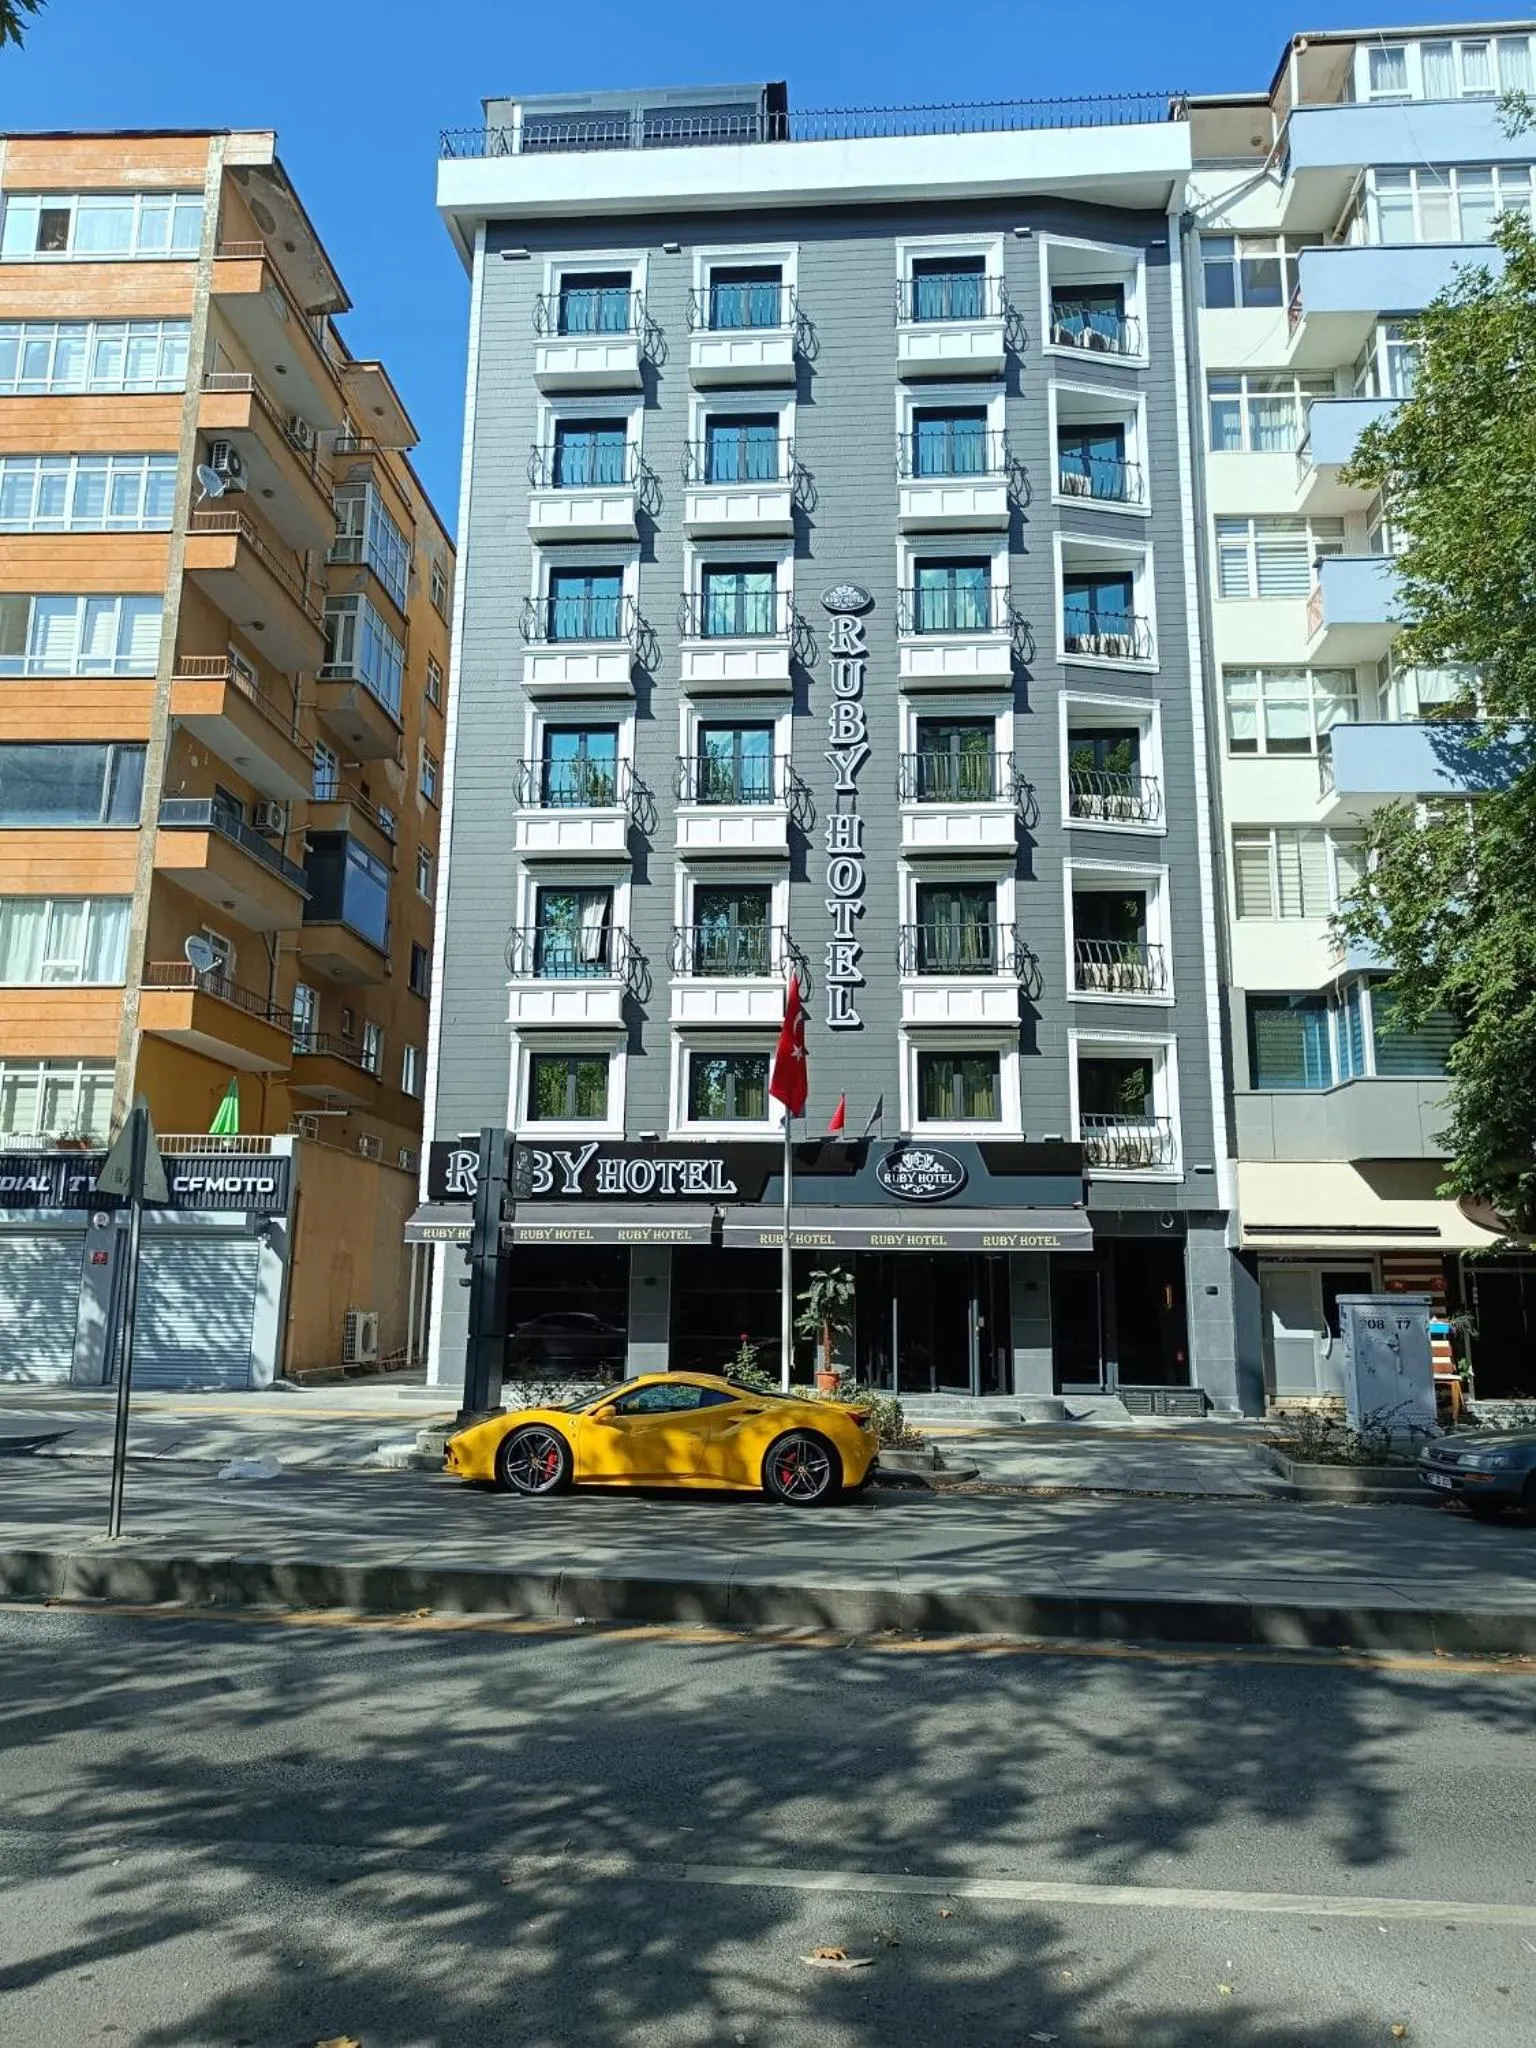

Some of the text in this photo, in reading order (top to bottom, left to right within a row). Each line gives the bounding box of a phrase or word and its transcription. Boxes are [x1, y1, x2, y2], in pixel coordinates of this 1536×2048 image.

[823, 614, 870, 792] RUBY
[824, 813, 865, 1028] HOTEL
[445, 1142, 738, 1196] RBY HOTEL
[0, 1176, 50, 1192] DIAL
[884, 1171, 957, 1184] RUBY HOTEL
[172, 1176, 275, 1193] CFMOTO
[422, 1227, 457, 1239] RUBY
[519, 1228, 595, 1240] RUBY HOTEL
[617, 1228, 692, 1241] RUBY HOTEL
[795, 1233, 836, 1245] HOTEL
[870, 1233, 947, 1246] RUBY HOTEL
[983, 1234, 1061, 1247] RUBY HOTEL
